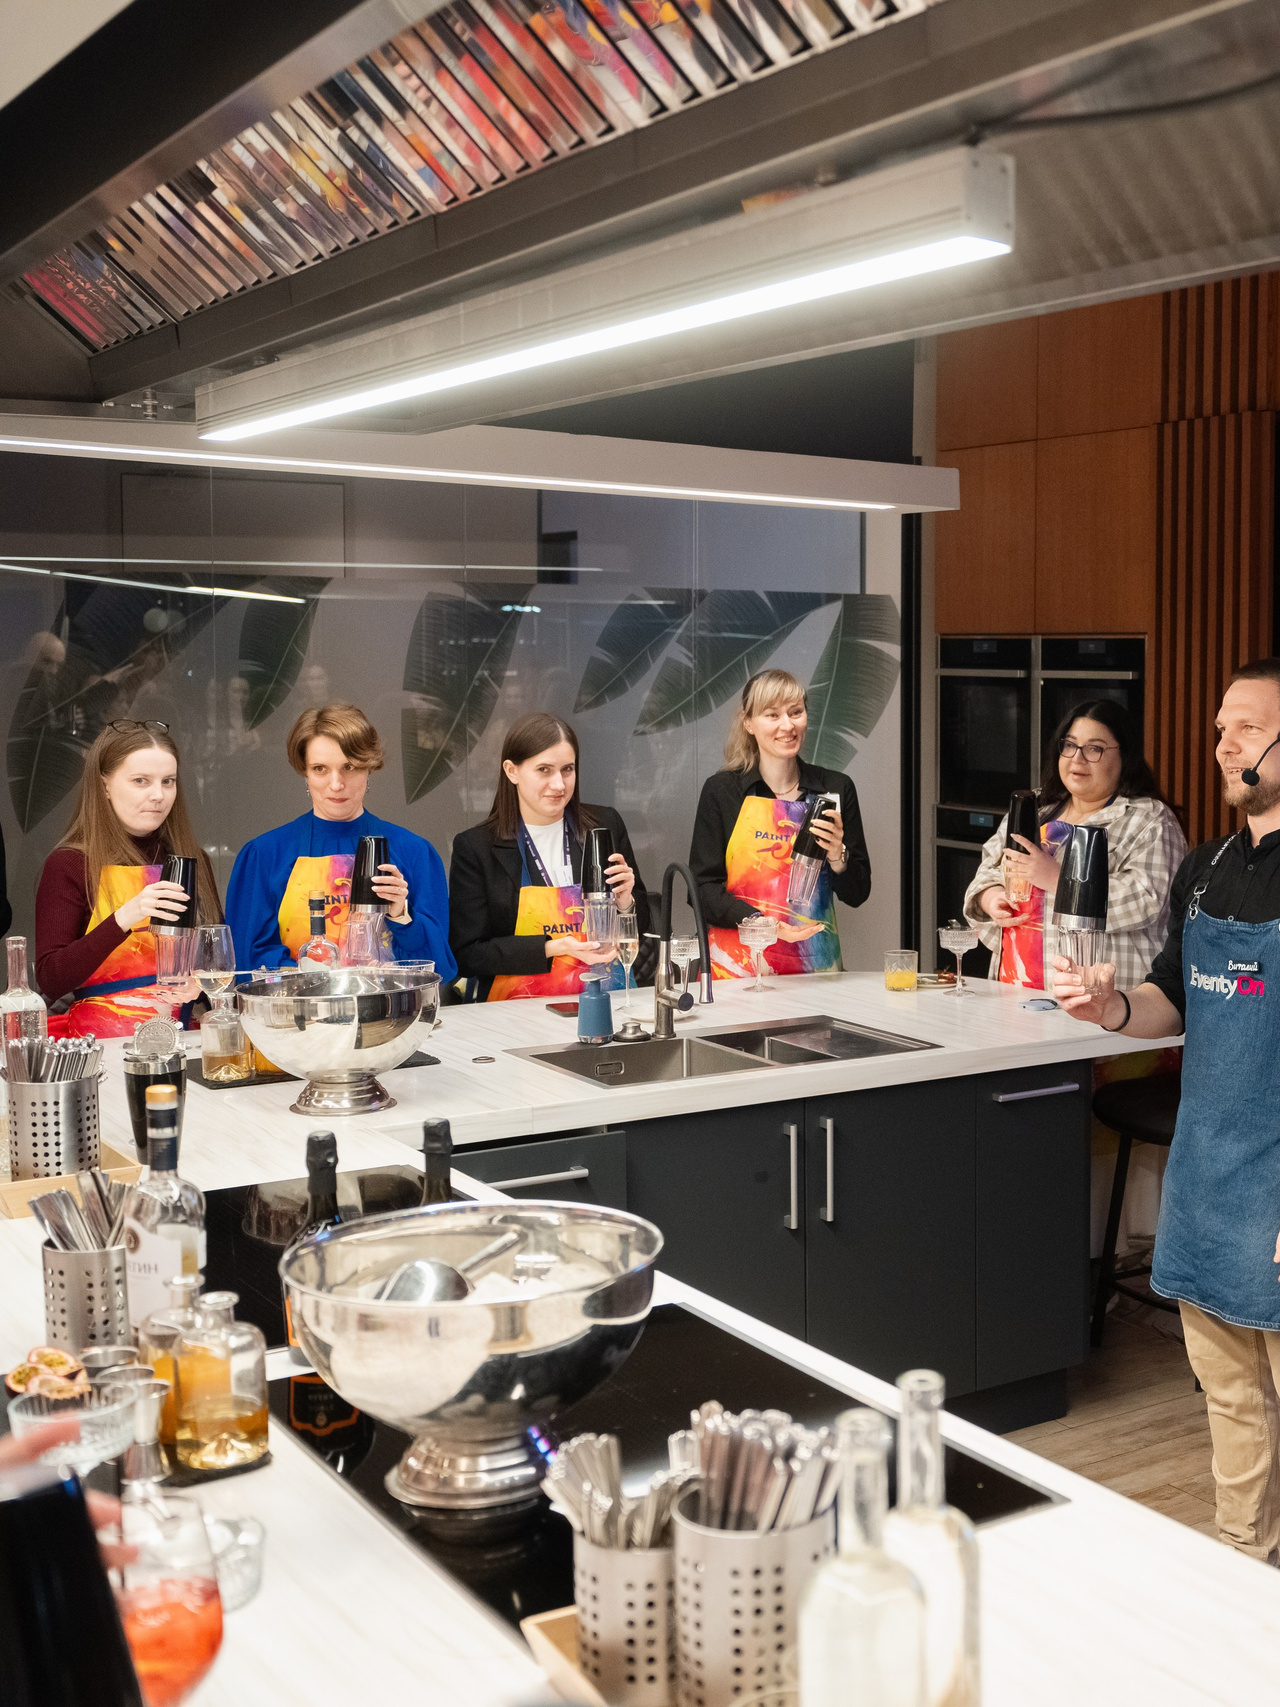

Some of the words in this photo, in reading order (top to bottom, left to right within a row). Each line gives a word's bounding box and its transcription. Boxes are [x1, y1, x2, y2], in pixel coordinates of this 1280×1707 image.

[755, 830, 790, 842] PAINT
[543, 922, 580, 935] PAINT
[1227, 959, 1259, 972] Виталий
[1189, 963, 1265, 1000] EventyOn
